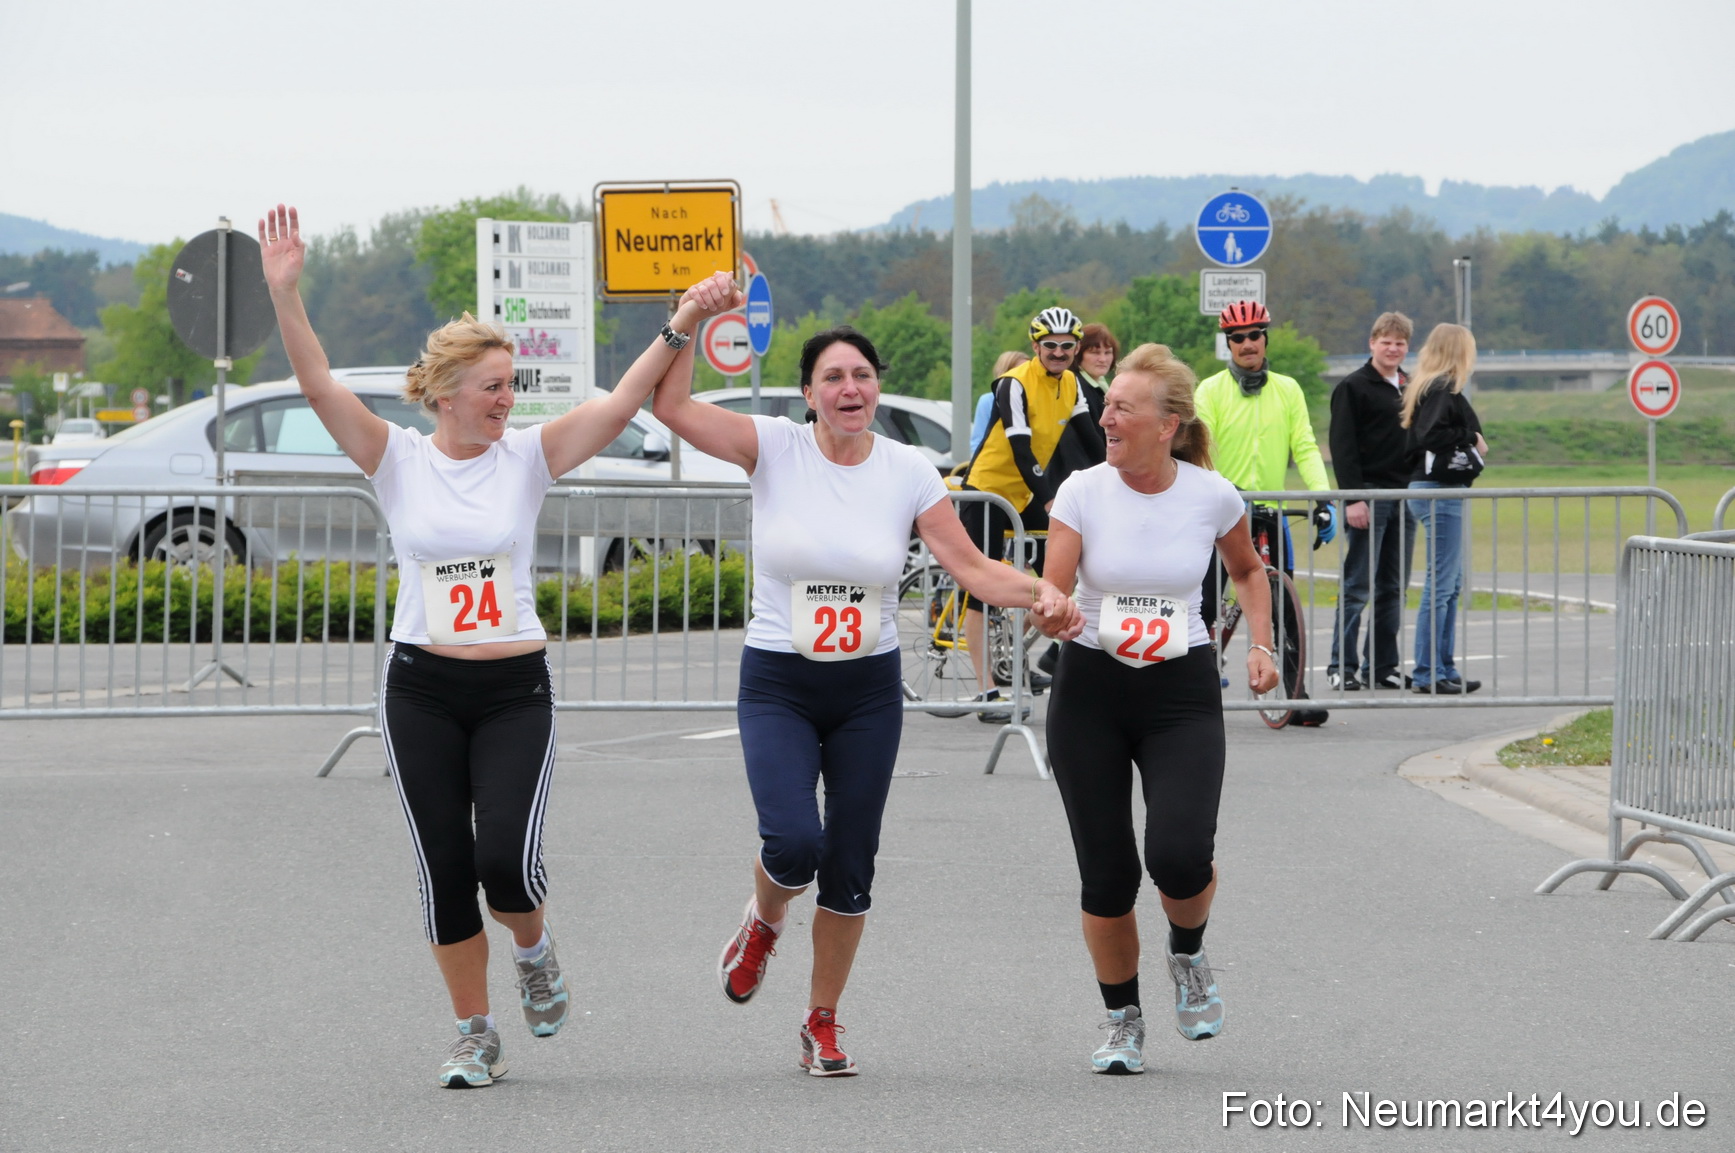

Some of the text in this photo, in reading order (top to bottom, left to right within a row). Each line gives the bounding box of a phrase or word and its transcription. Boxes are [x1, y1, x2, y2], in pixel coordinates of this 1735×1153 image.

[651, 206, 688, 219] Nach
[616, 227, 723, 252] Neumarkt
[653, 262, 691, 276] 5 km
[1212, 275, 1254, 286] Landwirt-
[1208, 287, 1258, 297] schaftlicher
[505, 298, 527, 323] SHB
[1641, 314, 1668, 339] 60
[436, 561, 477, 576] MEYER
[436, 570, 479, 583] WERBUNG
[806, 585, 847, 595] MEYER
[806, 594, 848, 602] WERBUNG
[1117, 596, 1158, 607] MEYER
[450, 580, 502, 633] 24
[1116, 606, 1158, 615] WERBUNG
[812, 606, 862, 654] 23
[1115, 617, 1170, 662] 22
